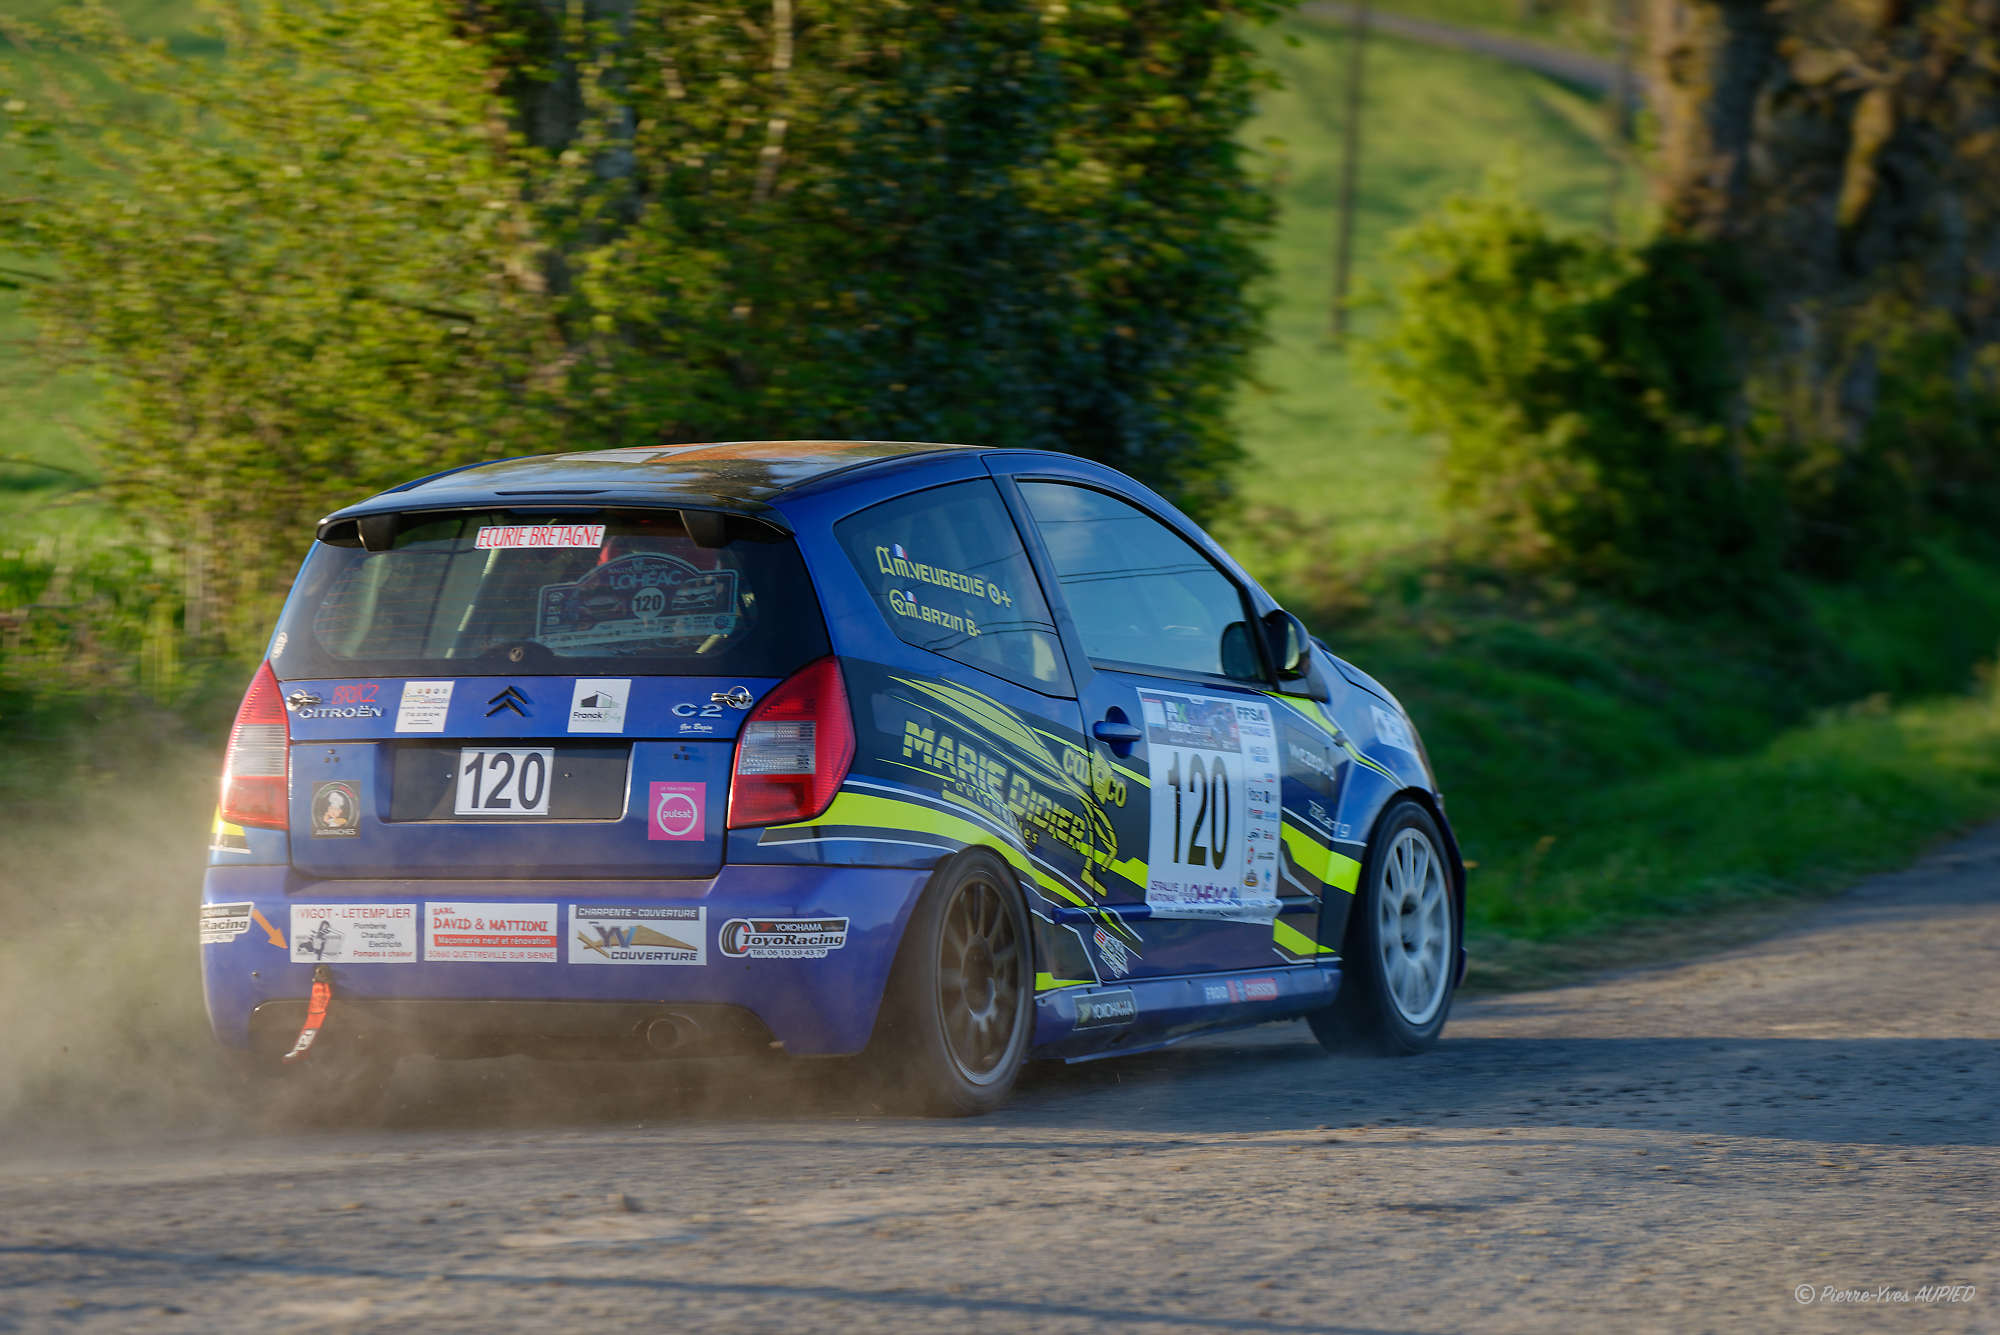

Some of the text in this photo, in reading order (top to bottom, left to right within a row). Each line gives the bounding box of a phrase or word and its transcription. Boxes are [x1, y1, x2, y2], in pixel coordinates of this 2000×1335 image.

[479, 525, 604, 547] ECURIE BRETAGNE
[634, 594, 662, 612] 120
[299, 705, 384, 720] CITROËN
[573, 711, 602, 719] Franck
[671, 703, 723, 718] C2
[465, 751, 546, 810] 120
[663, 809, 692, 820] pulsat
[1167, 751, 1231, 871] 120
[342, 908, 411, 920] LETEMPLIER
[432, 917, 549, 932] DAVID & MATTIONI
[775, 922, 823, 932] YOKOHAMA
[743, 932, 844, 946] ToyoRacing
[611, 951, 698, 961] COUVERTURE
